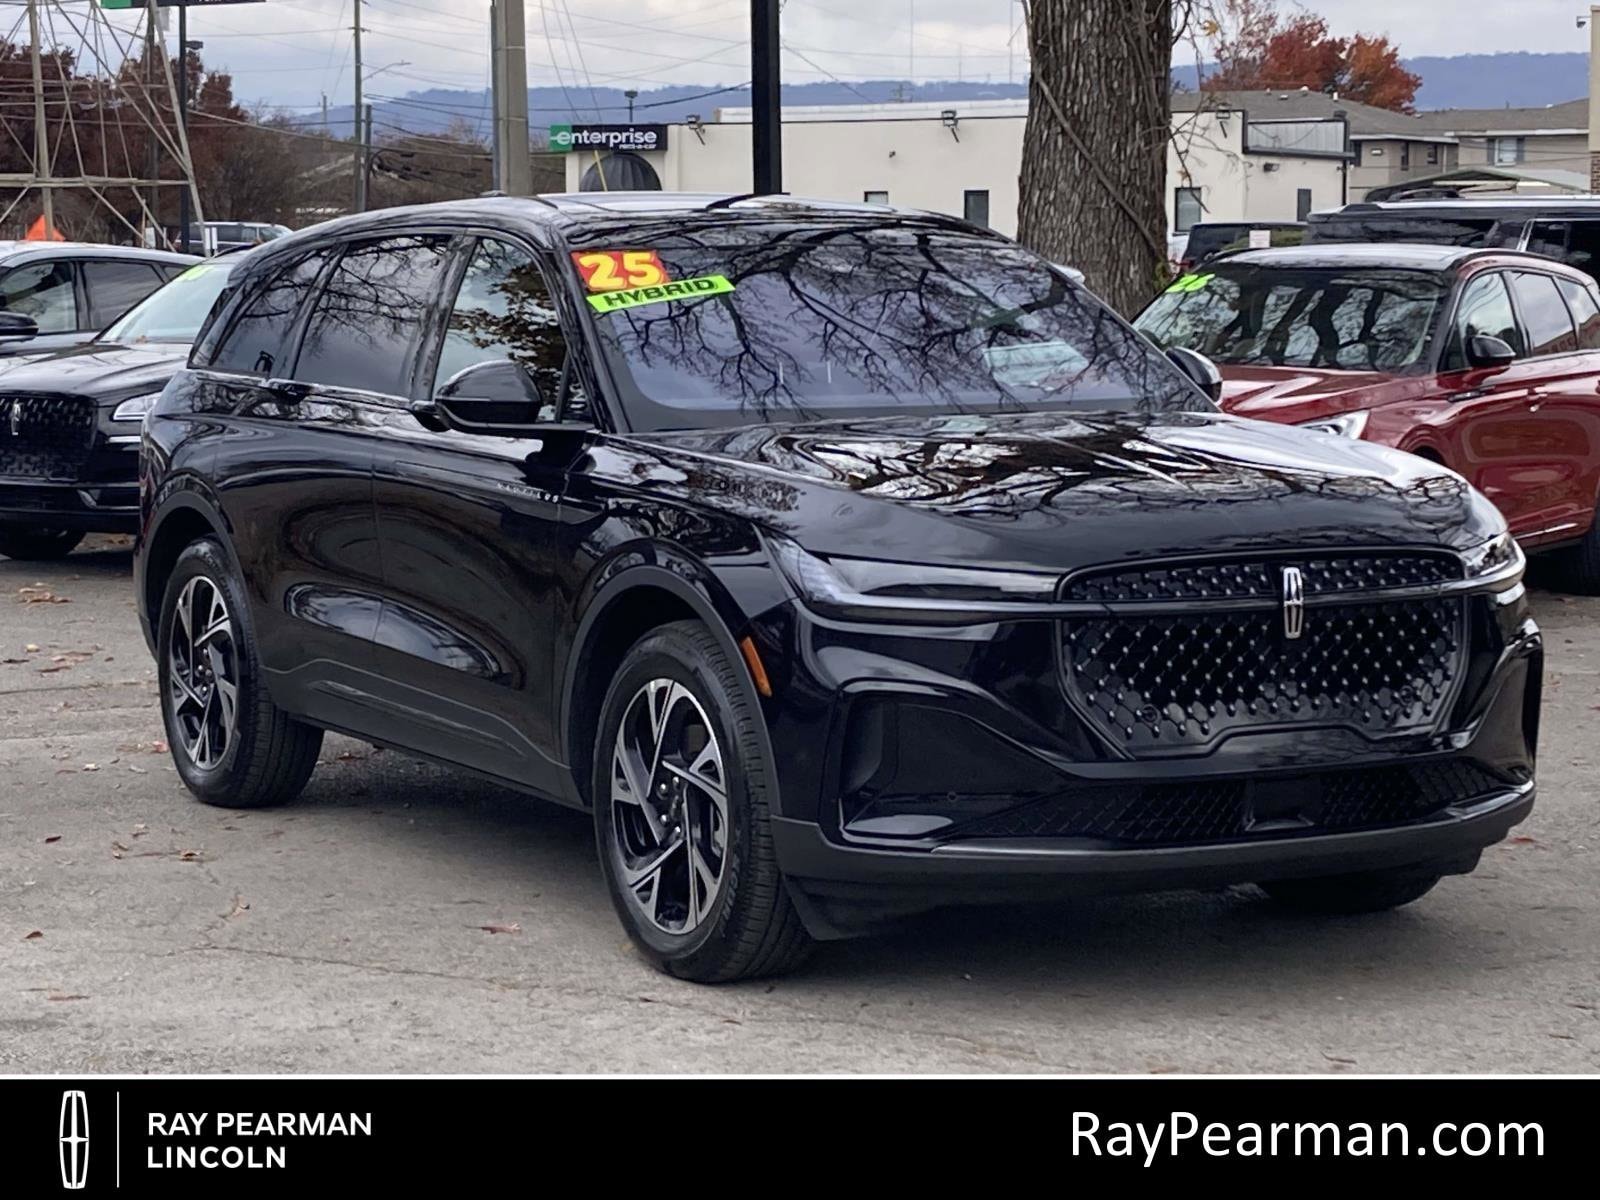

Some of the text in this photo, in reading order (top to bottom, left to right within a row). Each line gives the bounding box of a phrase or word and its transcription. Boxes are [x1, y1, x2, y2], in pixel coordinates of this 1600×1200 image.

[550, 128, 657, 147] enterprise
[579, 252, 662, 289] 25
[603, 278, 716, 306] HYBRID
